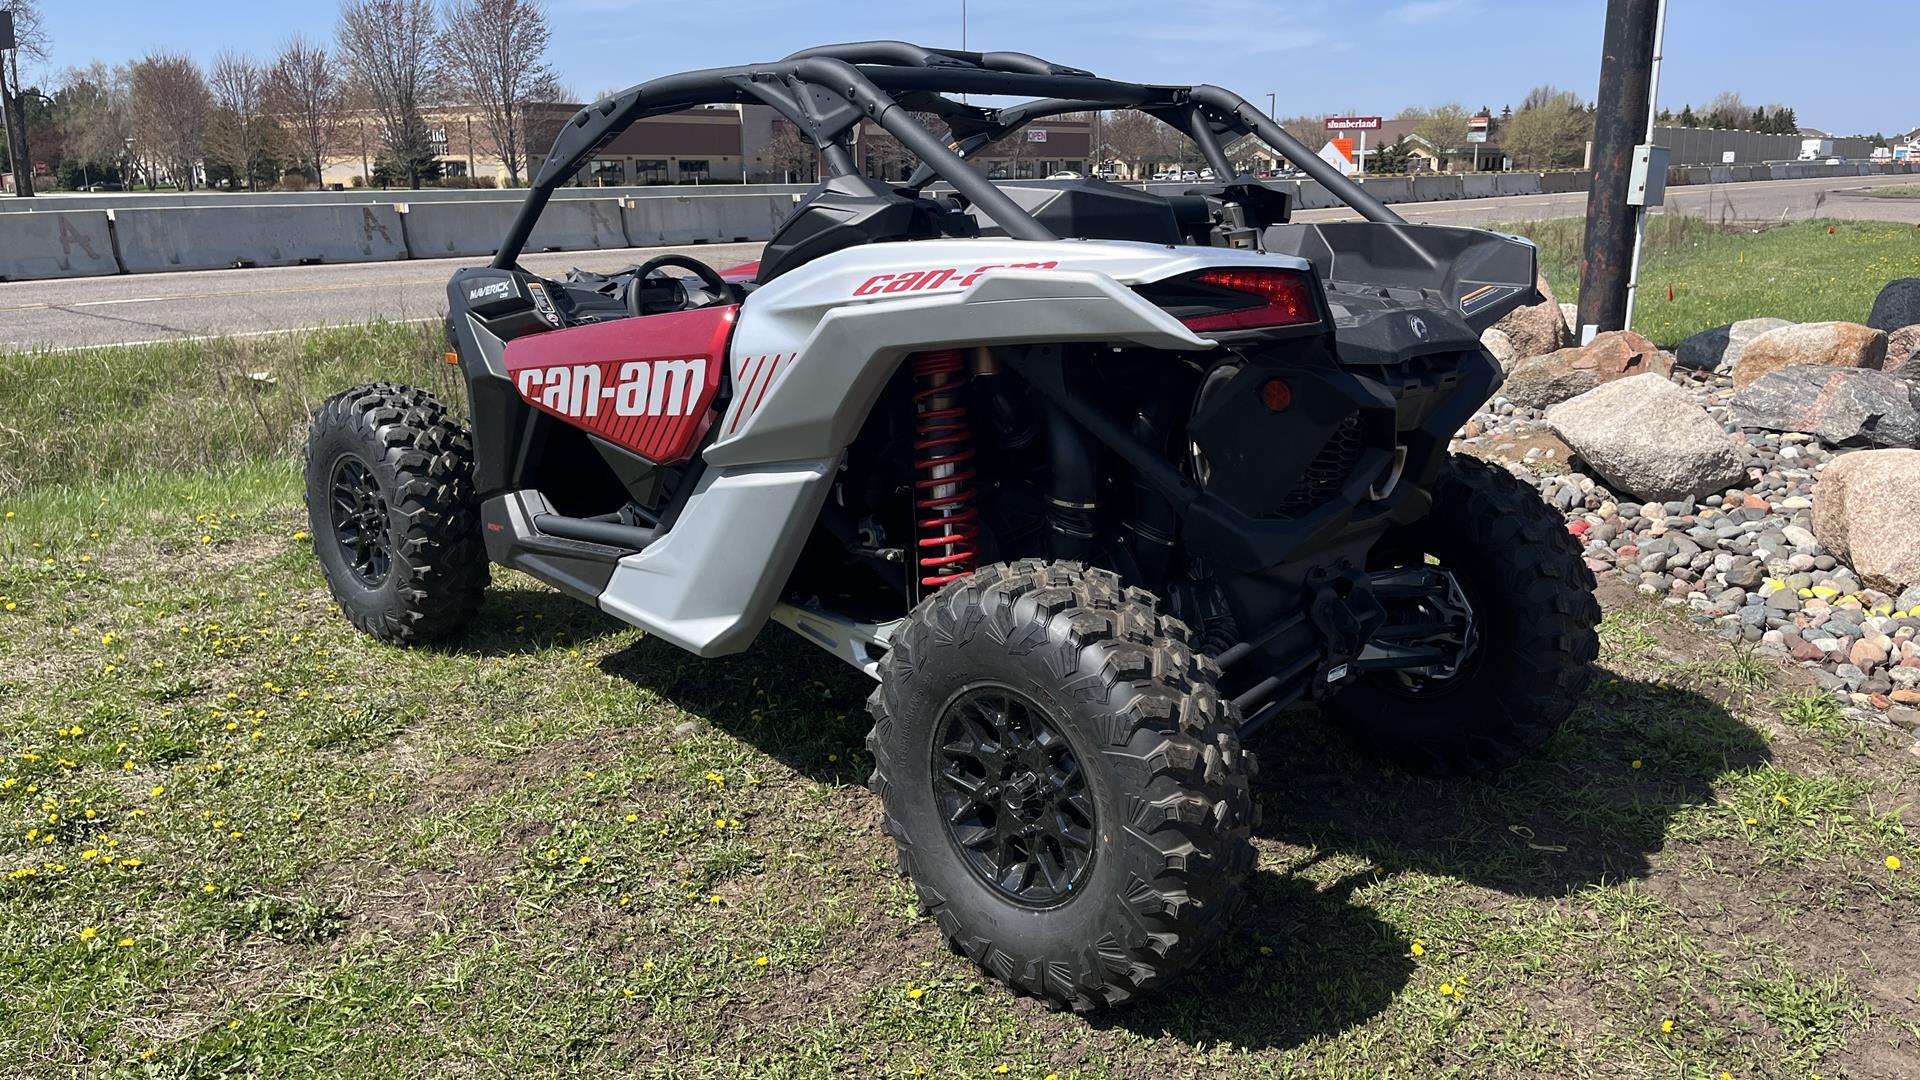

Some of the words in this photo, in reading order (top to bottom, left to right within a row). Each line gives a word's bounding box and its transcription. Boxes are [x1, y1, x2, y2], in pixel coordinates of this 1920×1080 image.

[1029, 131, 1046, 140] OPEN
[1327, 118, 1377, 129] slumberland
[58, 215, 99, 260] A
[363, 207, 393, 244] A
[469, 281, 510, 300] MAVERICK
[518, 358, 706, 417] can-am
